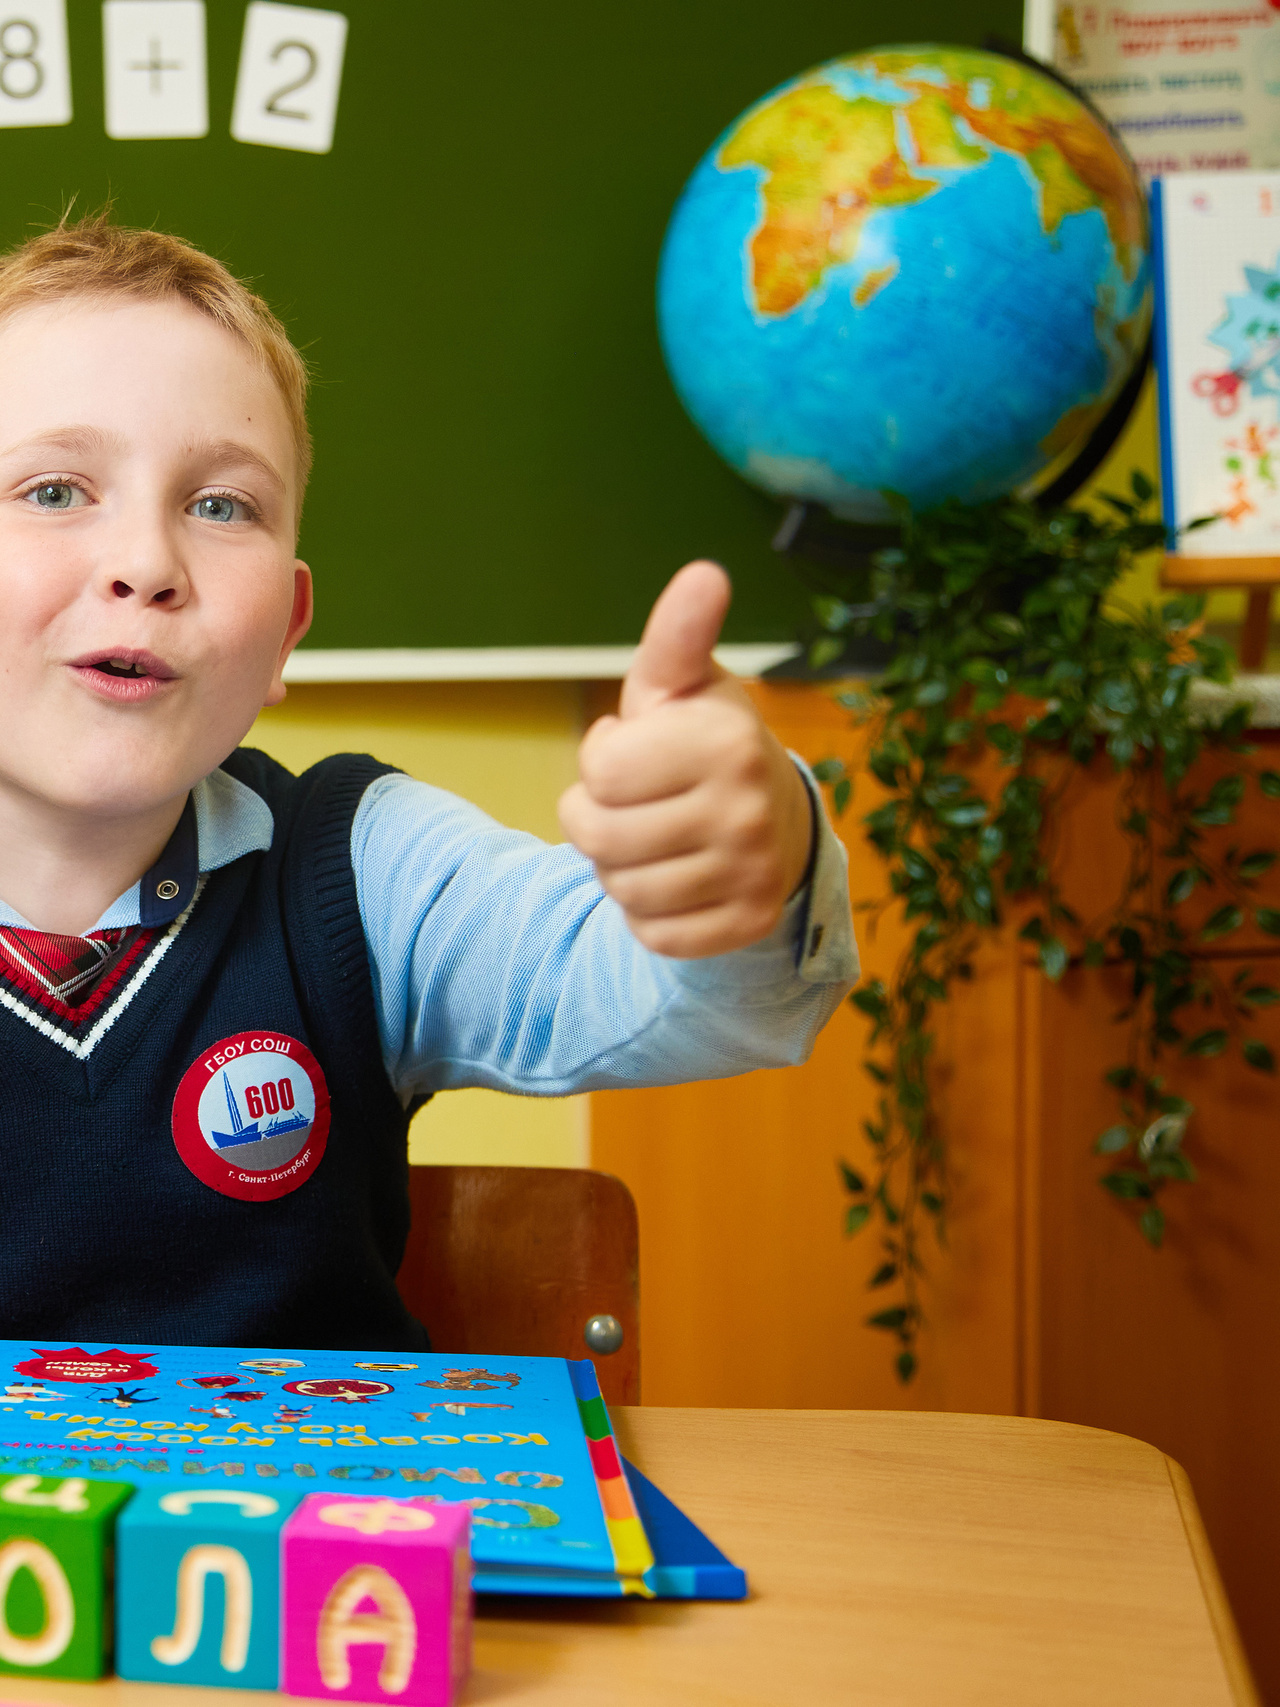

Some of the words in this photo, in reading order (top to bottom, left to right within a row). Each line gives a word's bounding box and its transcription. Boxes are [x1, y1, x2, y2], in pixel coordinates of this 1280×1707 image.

[264, 38, 319, 121] 2
[204, 1040, 246, 1074] ГБОУ
[250, 1038, 292, 1055] СОШ
[244, 1077, 296, 1119] 600
[238, 1148, 312, 1184] Санкт-Петербург
[45, 1365, 129, 1374] школы
[64, 1428, 276, 1447] косой
[226, 1422, 367, 1434] косу
[298, 1431, 550, 1447] Косарь
